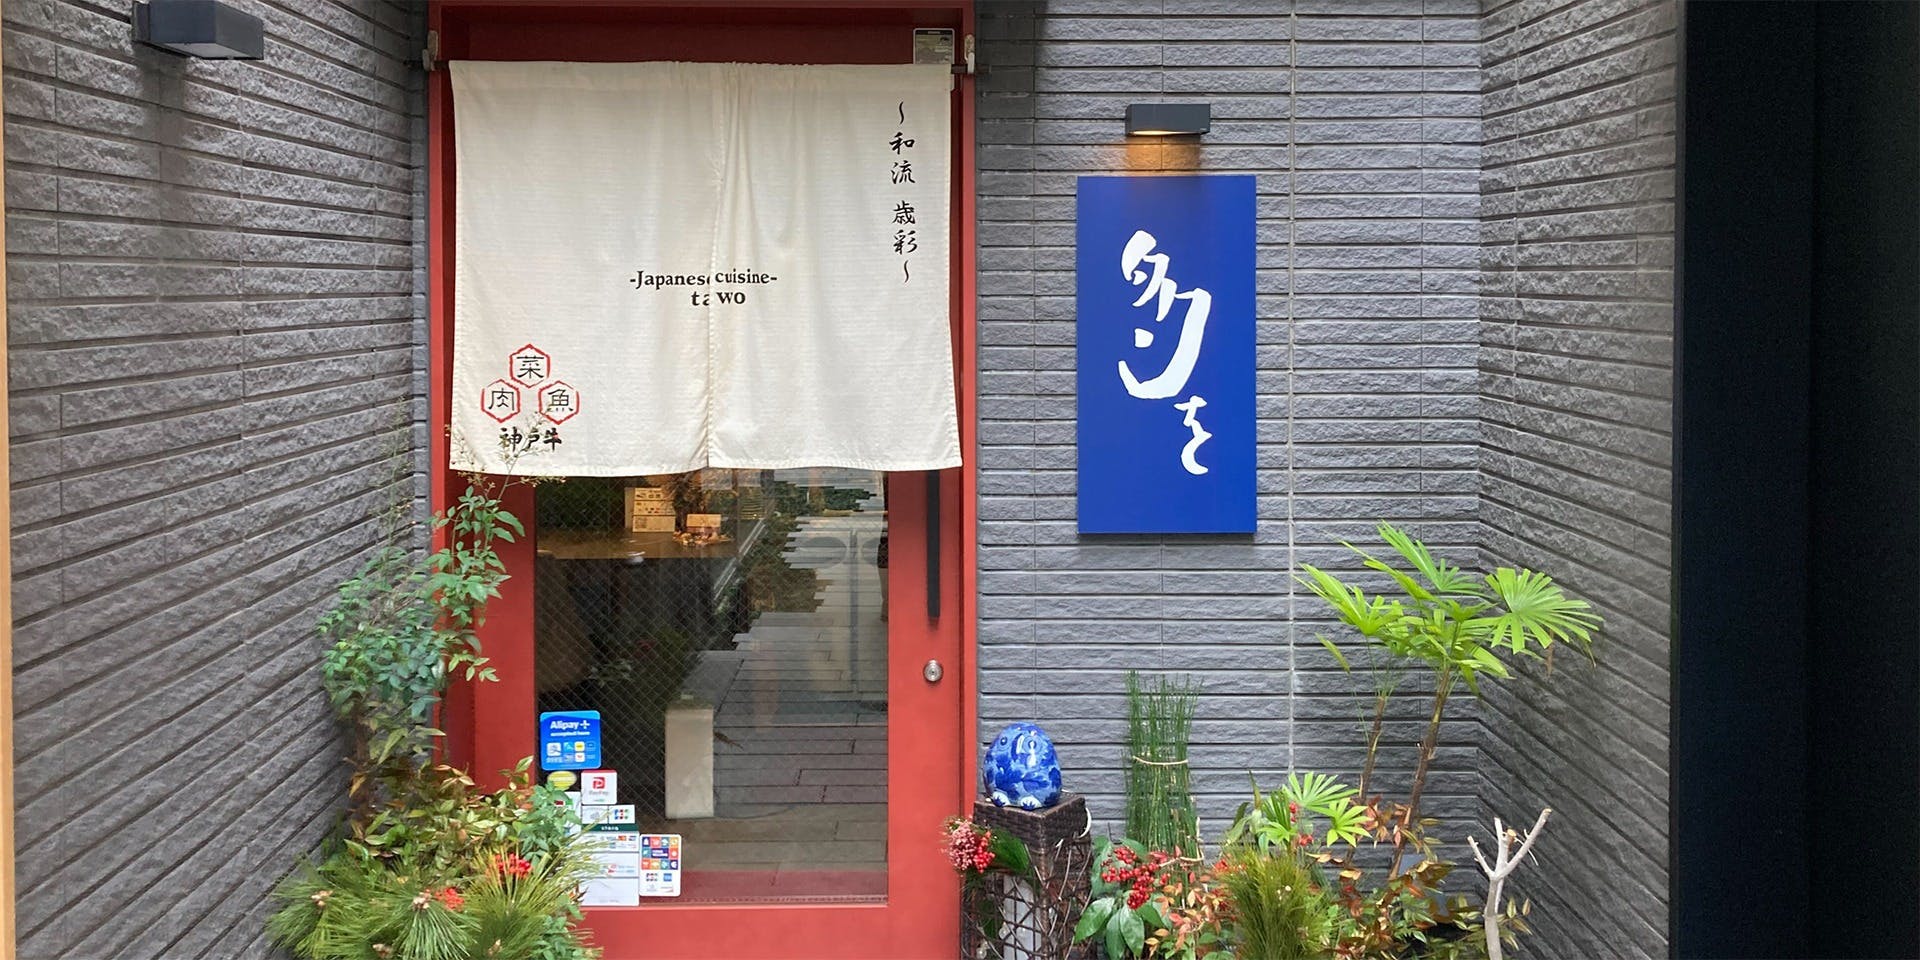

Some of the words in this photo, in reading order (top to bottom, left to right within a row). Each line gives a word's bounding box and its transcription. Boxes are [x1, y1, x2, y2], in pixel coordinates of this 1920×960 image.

[715, 268, 778, 284] cuisine-
[516, 355, 545, 379] 菜
[488, 387, 515, 411] 肉
[547, 388, 574, 412] 魚
